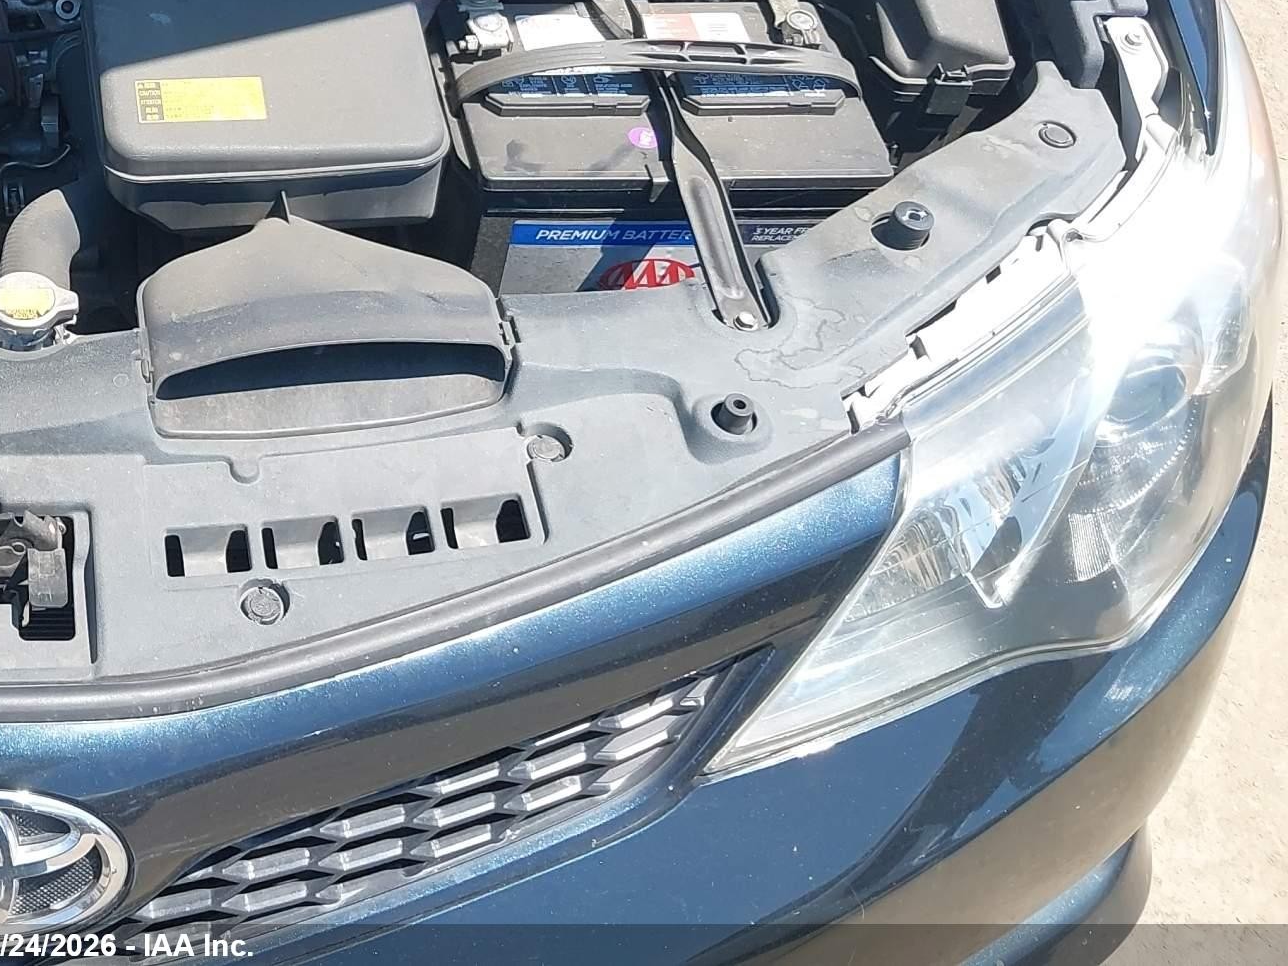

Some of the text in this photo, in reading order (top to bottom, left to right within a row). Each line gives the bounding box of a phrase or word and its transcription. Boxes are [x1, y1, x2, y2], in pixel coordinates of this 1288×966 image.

[536, 229, 692, 240] PREMIUM BATTER
[763, 227, 794, 235] YEAR
[601, 260, 690, 289] AAA
